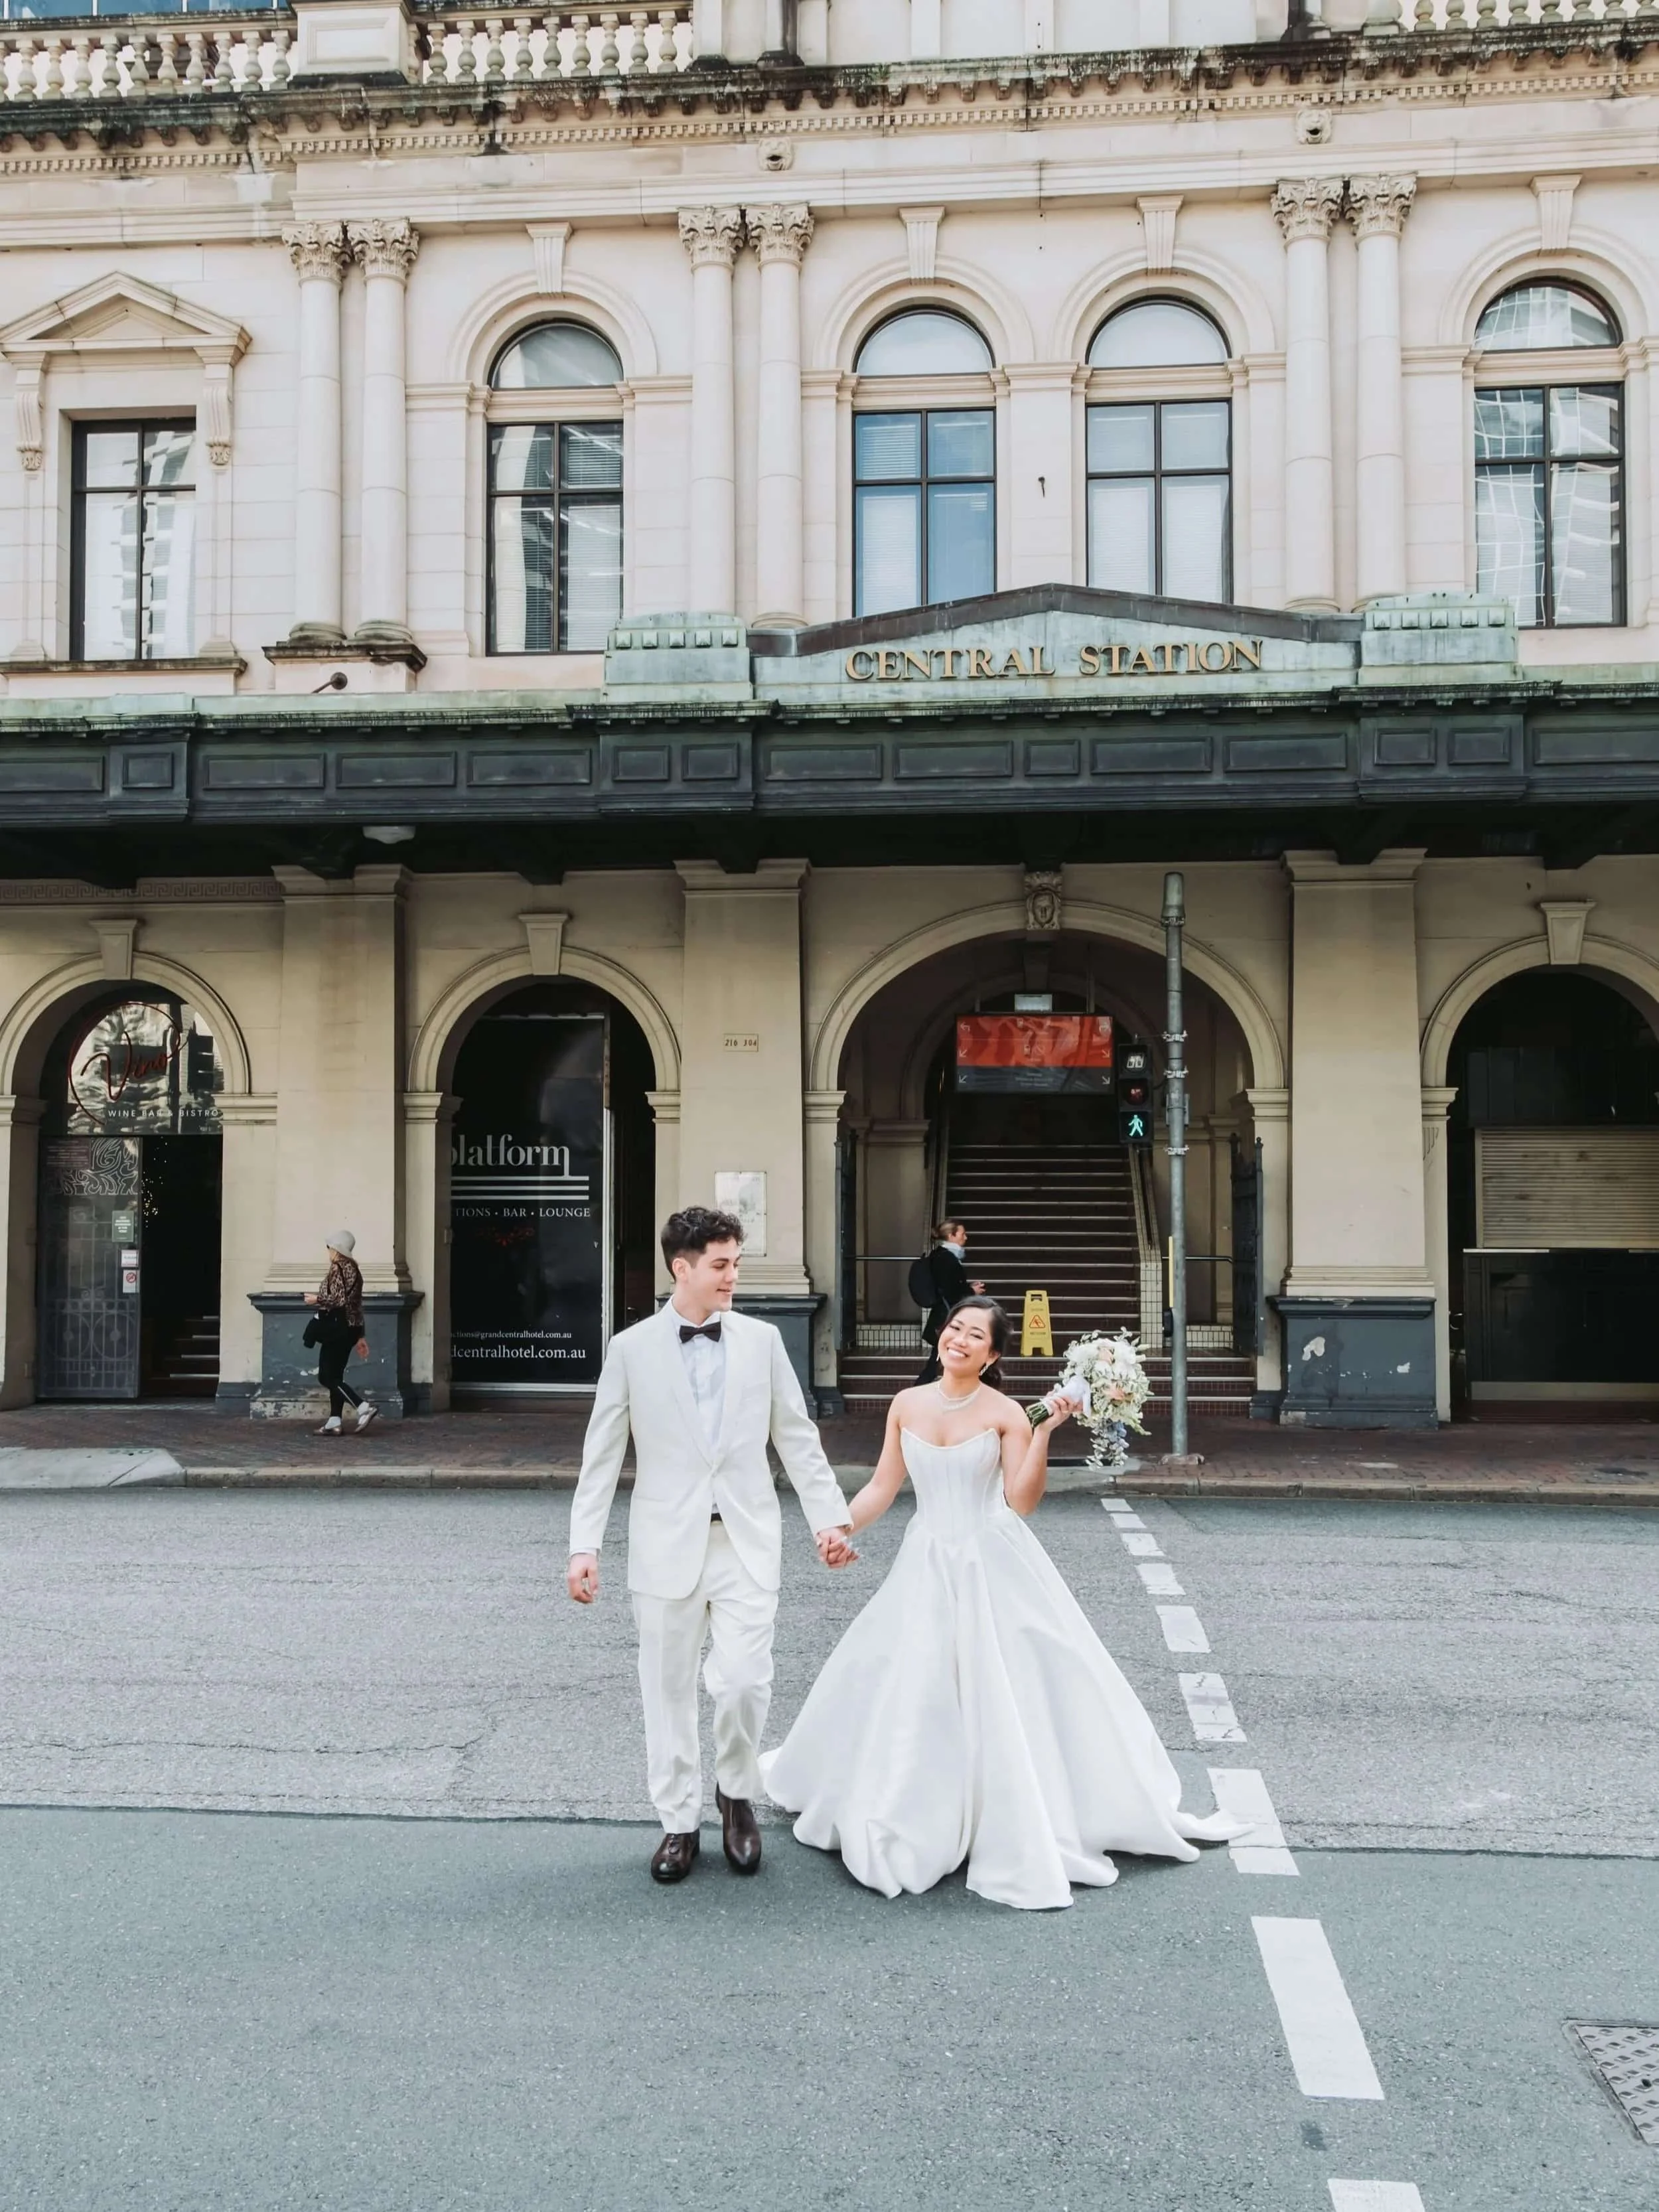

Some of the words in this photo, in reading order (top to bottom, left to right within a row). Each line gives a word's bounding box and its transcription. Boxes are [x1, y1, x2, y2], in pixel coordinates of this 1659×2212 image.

[845, 646, 1055, 680] CENTRAL
[1079, 639, 1263, 676] STATION
[108, 1109, 136, 1118] WINE
[141, 1109, 162, 1118] BAR
[179, 1108, 219, 1118] BISTRO
[503, 1207, 527, 1217] BAR
[539, 1207, 591, 1217] LOUNGE
